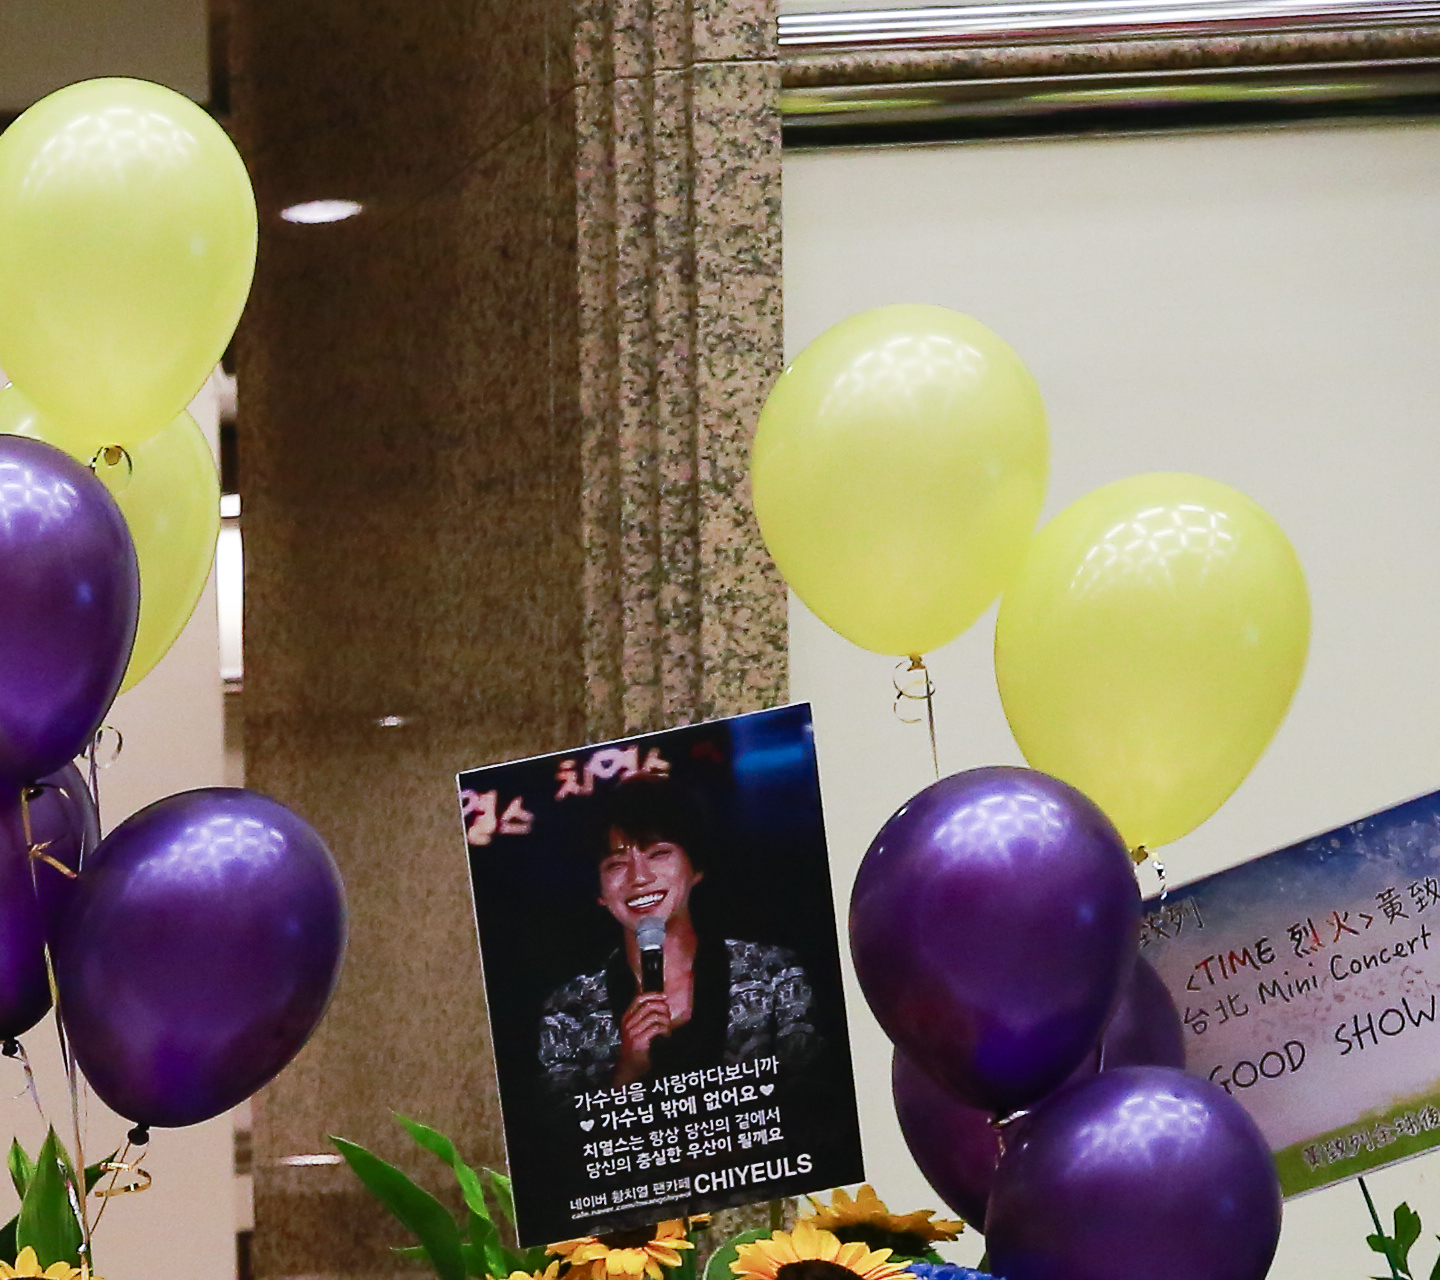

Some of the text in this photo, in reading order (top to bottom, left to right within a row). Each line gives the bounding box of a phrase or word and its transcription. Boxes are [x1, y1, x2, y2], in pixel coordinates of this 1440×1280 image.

[1184, 924, 1432, 1035] 台北 Mini Concert
[1335, 995, 1436, 1056] SHOW
[574, 1055, 780, 1113] 가수님을 사랑하다보니까
[600, 1085, 758, 1131] 가수님 밖에 없어요
[583, 1134, 645, 1159] 치열스는
[649, 1126, 679, 1146] 항상
[684, 1117, 730, 1140] 당신의
[586, 1156, 631, 1179] 당신의
[636, 1146, 682, 1169] 충실한
[687, 1136, 732, 1159] 우산이
[569, 1193, 607, 1211] 네이버
[611, 1185, 649, 1204] 황치열
[694, 1154, 813, 1194] CHIYEULS
